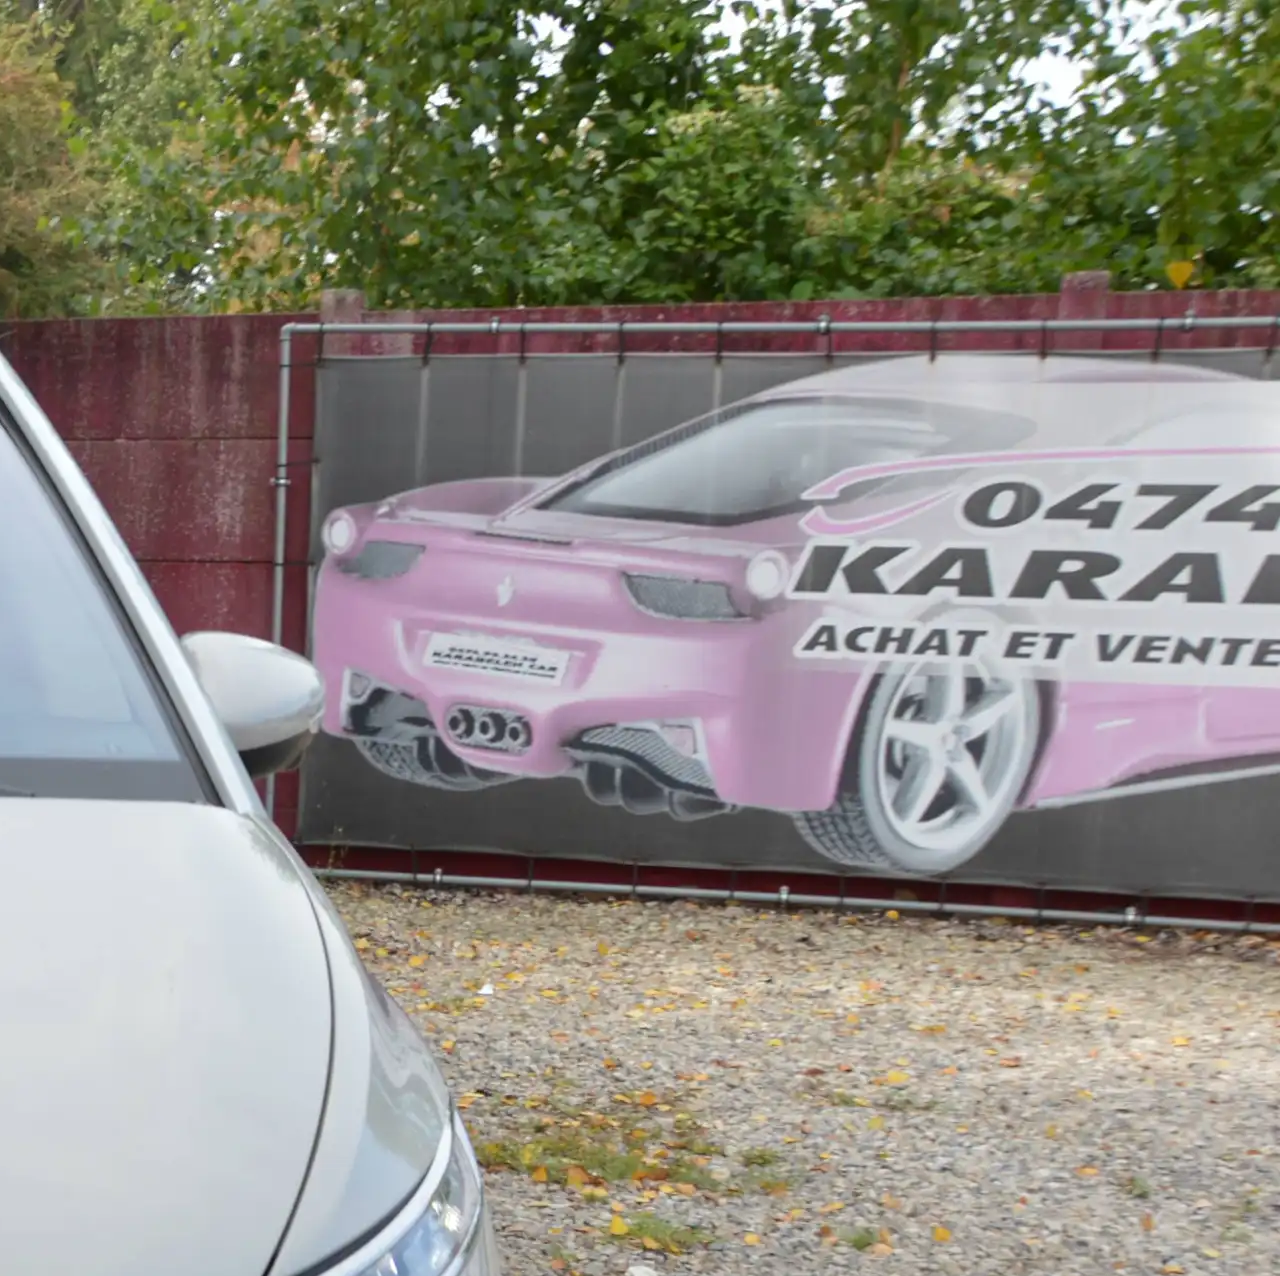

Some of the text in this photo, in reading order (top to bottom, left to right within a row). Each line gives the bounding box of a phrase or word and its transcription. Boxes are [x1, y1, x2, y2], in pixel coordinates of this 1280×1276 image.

[961, 480, 1280, 532] 0474
[801, 623, 1280, 667] ACHAT ET VENTE
